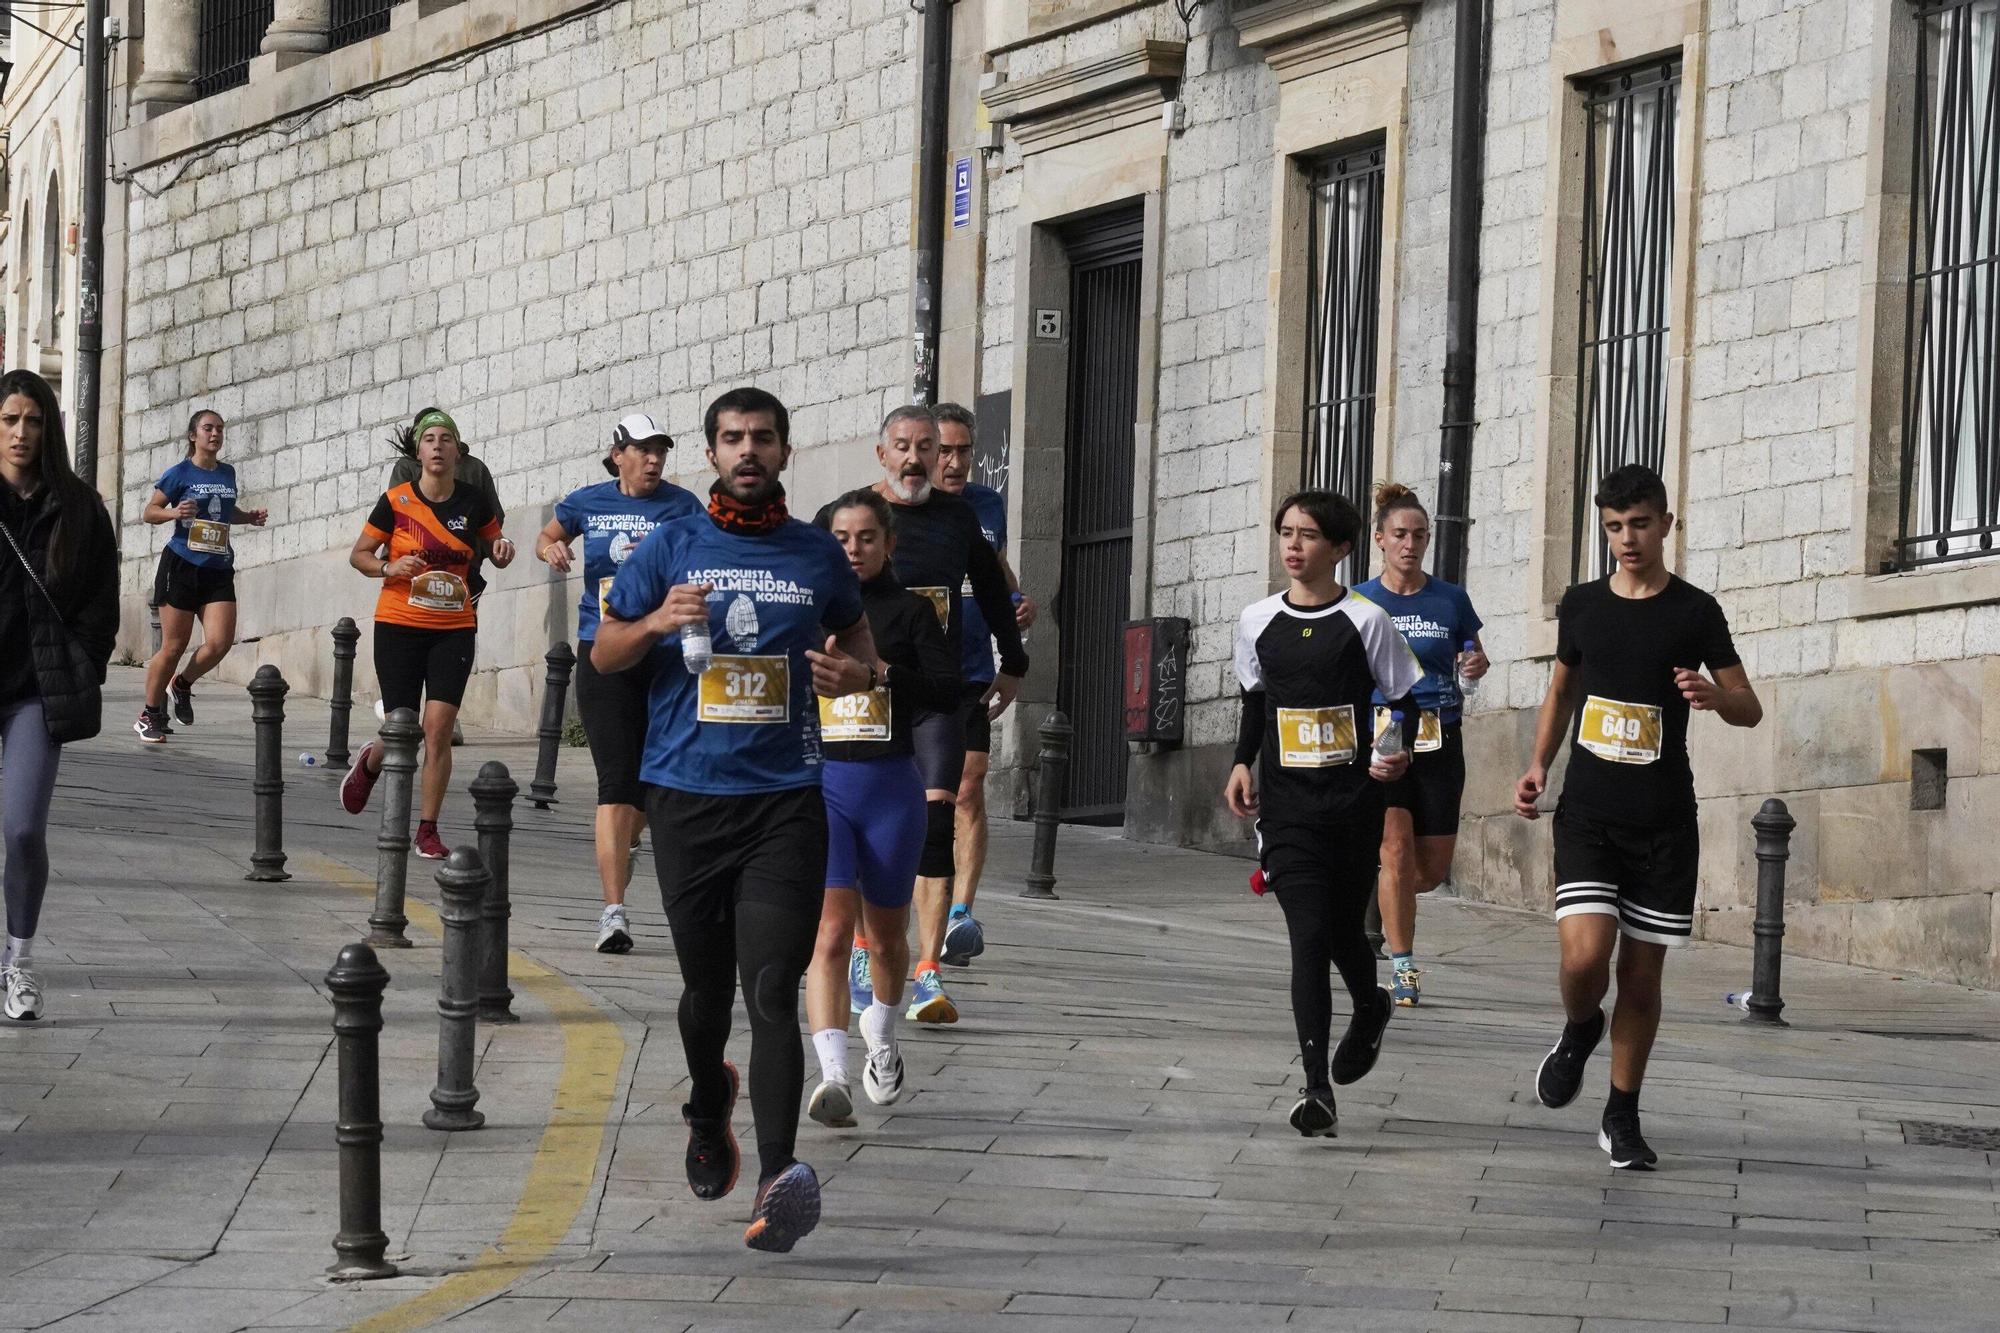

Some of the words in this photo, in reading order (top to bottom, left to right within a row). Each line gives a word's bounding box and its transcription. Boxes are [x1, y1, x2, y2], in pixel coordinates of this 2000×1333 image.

[1041, 314, 1056, 334] 3
[597, 514, 646, 522] CONQUISTA
[202, 528, 221, 542] 537
[687, 570, 701, 580] LA
[703, 569, 773, 580] CONQUISTA
[427, 580, 454, 597] 450
[708, 578, 798, 593] ALMENDRA
[755, 592, 814, 606] KONKISTA
[1408, 630, 1449, 639] KONKISTA
[725, 671, 767, 697] 312
[831, 695, 871, 718] 432
[1297, 722, 1335, 746] 648
[1601, 714, 1641, 741] 649
